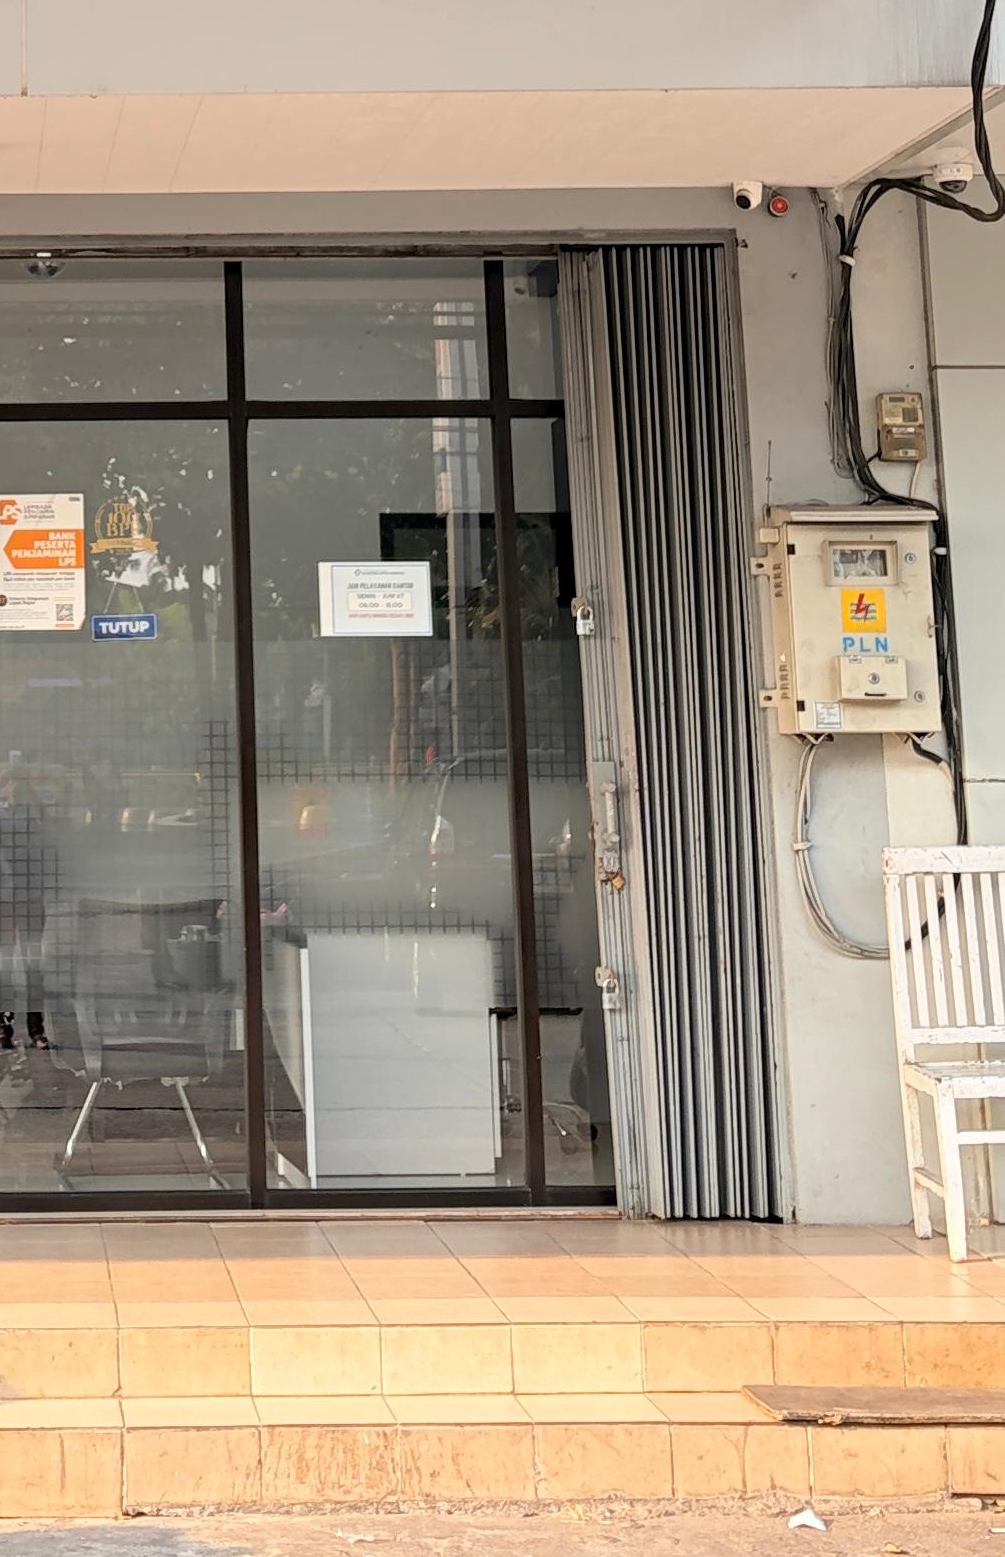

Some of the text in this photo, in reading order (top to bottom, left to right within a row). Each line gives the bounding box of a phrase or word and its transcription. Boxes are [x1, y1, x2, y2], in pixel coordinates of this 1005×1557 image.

[48, 531, 76, 541] BANK
[33, 540, 76, 549] PESERTA
[11, 548, 76, 558] PENJAMINAN
[58, 557, 77, 567] LPS
[98, 620, 150, 634] TUTUP
[842, 636, 888, 653] PLN
